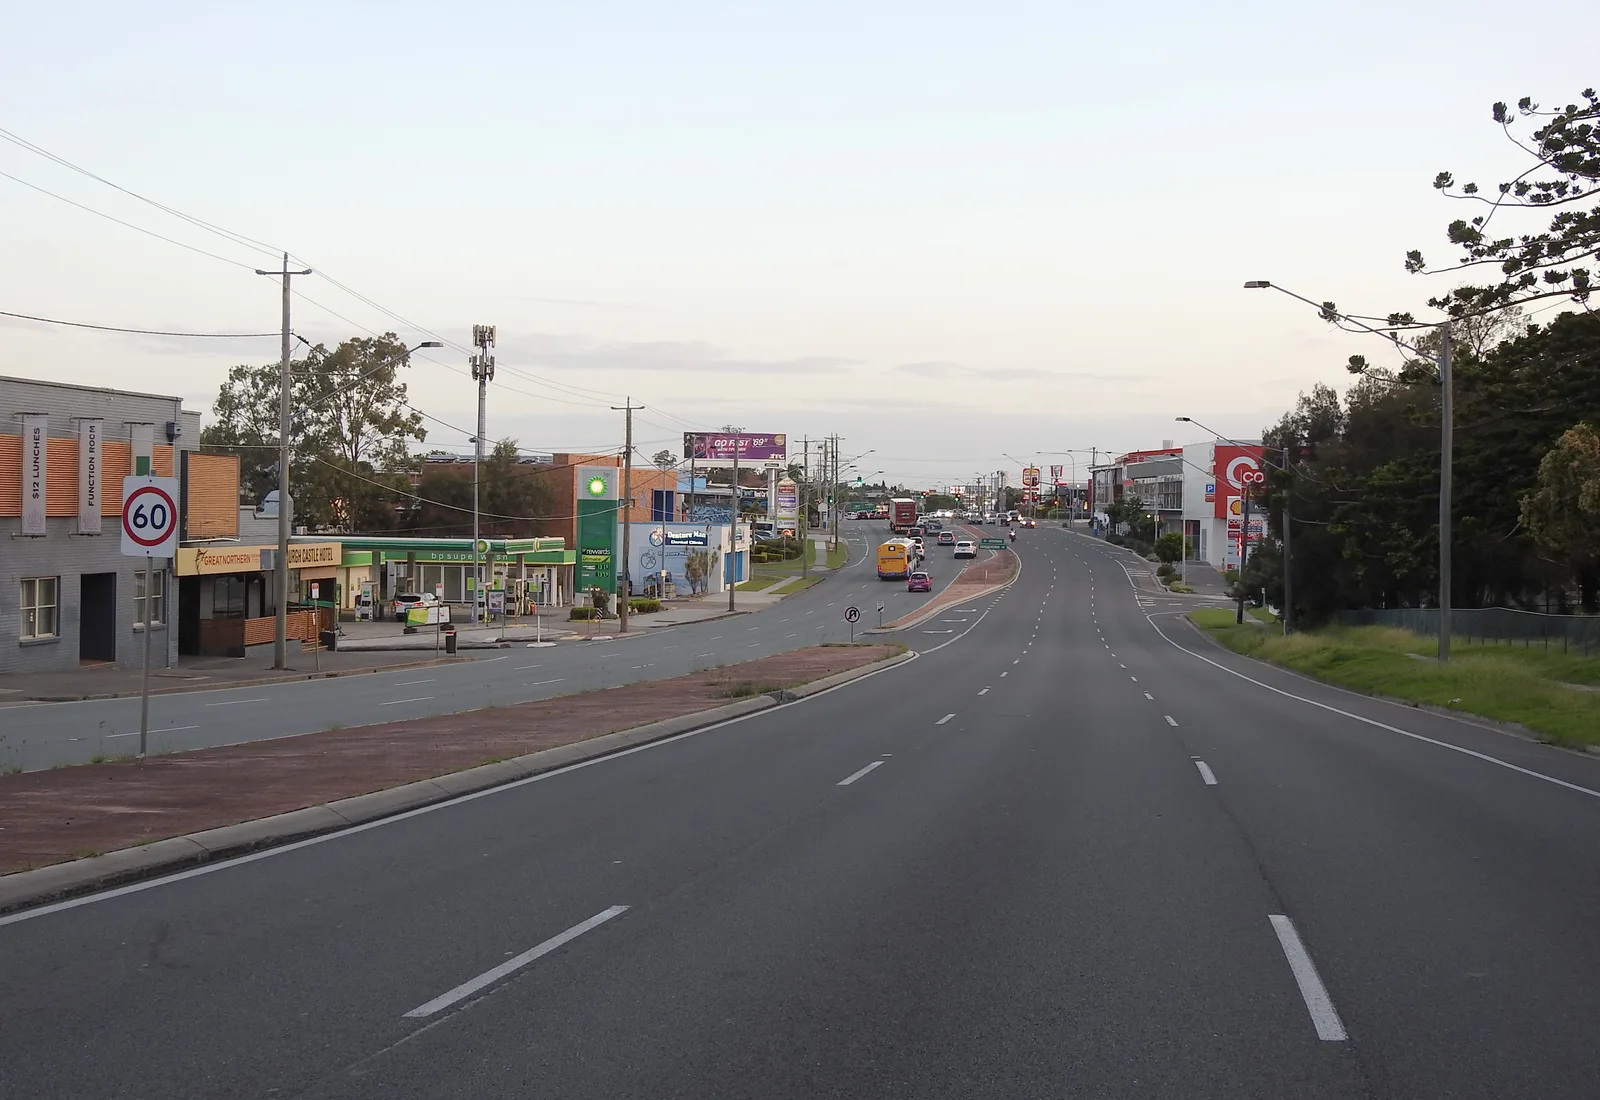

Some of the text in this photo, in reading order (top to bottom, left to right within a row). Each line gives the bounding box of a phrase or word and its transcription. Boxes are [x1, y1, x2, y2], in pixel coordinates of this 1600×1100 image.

[714, 439, 727, 447] GO
[728, 439, 750, 447] FST
[32, 427, 40, 478] LUNCHES
[88, 457, 96, 507] FUNCTION
[132, 503, 167, 530] 60
[693, 530, 706, 539] Man
[204, 555, 223, 566] GREAT
[222, 553, 251, 565] NORTHERN
[302, 548, 319, 562] CASTLE
[319, 547, 334, 561] HOTEL
